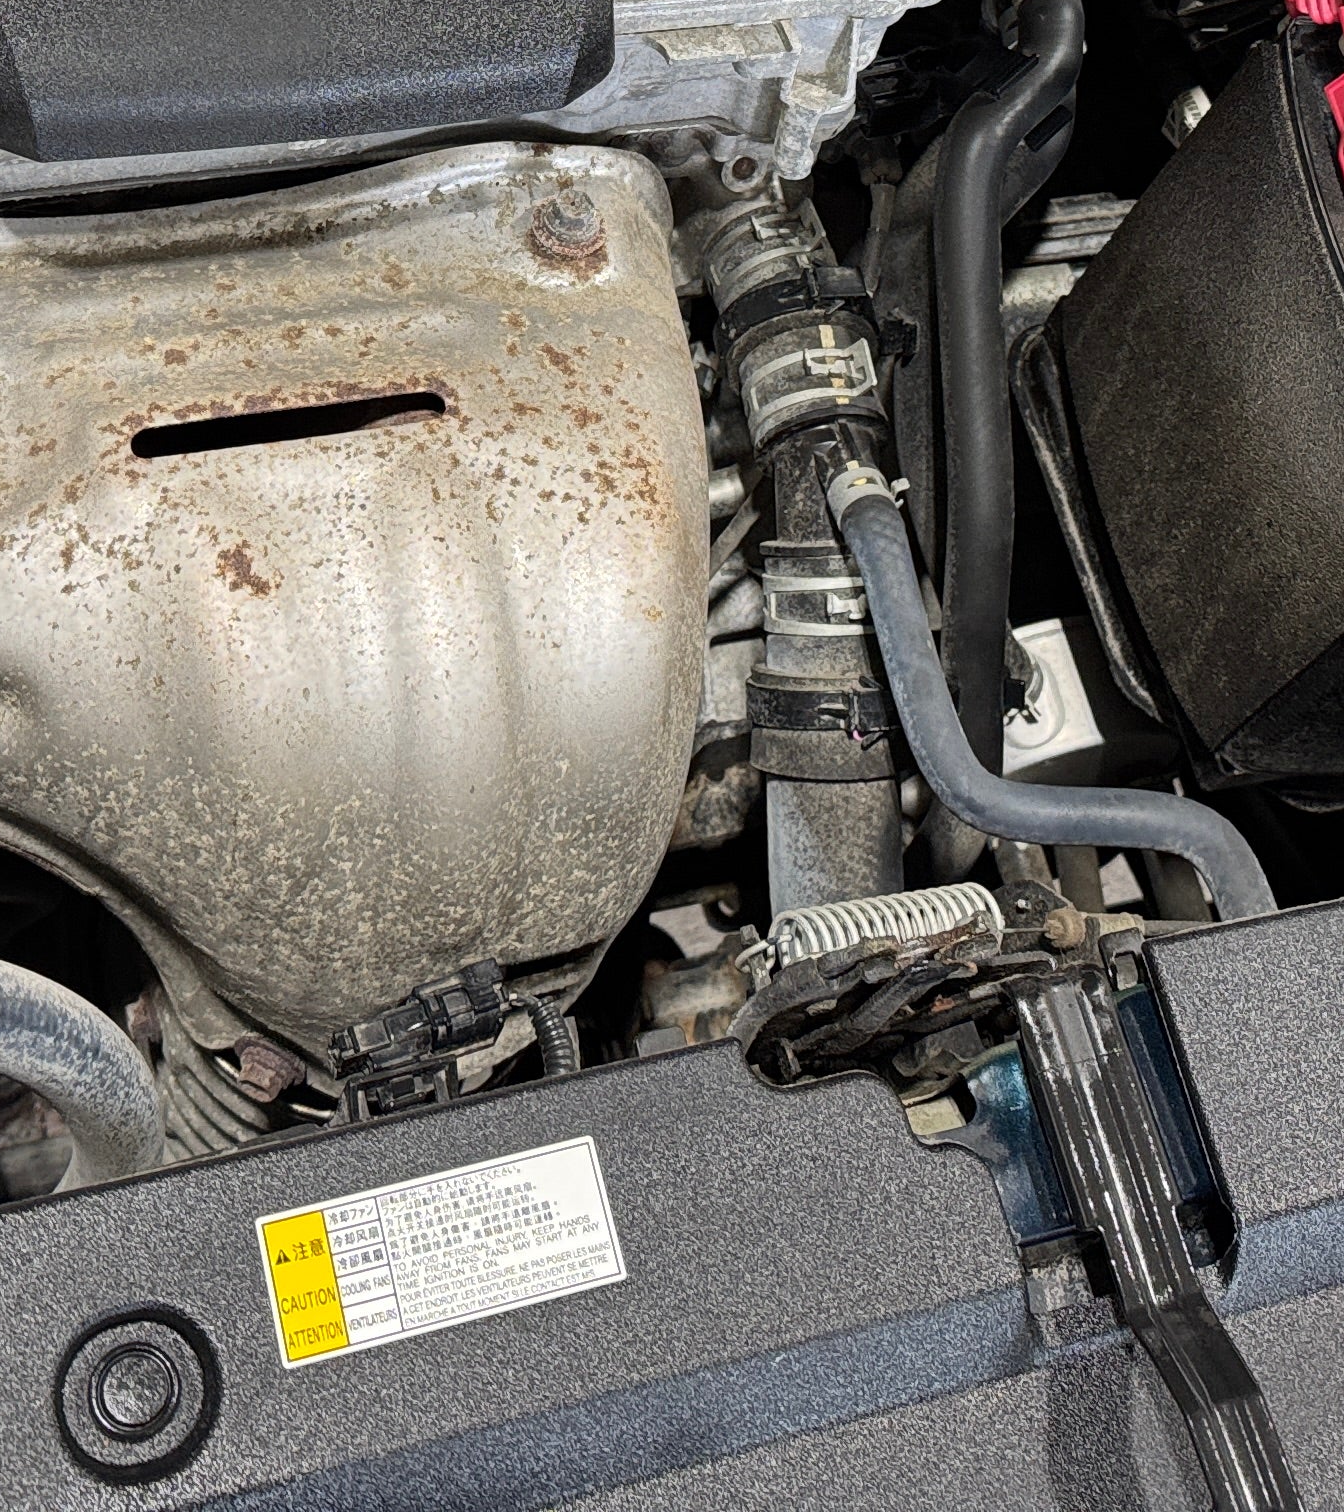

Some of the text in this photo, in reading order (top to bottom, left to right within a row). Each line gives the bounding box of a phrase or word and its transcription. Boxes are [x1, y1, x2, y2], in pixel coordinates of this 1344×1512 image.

[326, 1203, 375, 1226] 冷却ファン
[291, 1236, 326, 1261] 注意
[331, 1225, 380, 1249] 冷却风扇
[393, 1261, 407, 1273] TO
[410, 1253, 438, 1268] AVOID
[442, 1239, 491, 1260] PERSONAL
[531, 1223, 556, 1237] KEEP
[558, 1214, 591, 1230] HANDS
[395, 1268, 421, 1282] AWAY
[424, 1260, 451, 1275] FROM
[485, 1245, 509, 1259] FANS
[512, 1239, 532, 1252] MAY
[534, 1230, 563, 1246] START
[566, 1226, 579, 1238] AT
[581, 1221, 601, 1234] ANY
[340, 1273, 391, 1297] COOLING FANS
[397, 1278, 420, 1292] TIME
[423, 1266, 465, 1285] IGNITION
[469, 1262, 479, 1273] IS
[399, 1289, 422, 1304] POUR
[450, 1275, 476, 1290] TOUTE
[476, 1264, 517, 1284] BLESSURE
[518, 1260, 530, 1273] NE
[530, 1256, 546, 1269] PAS
[545, 1249, 572, 1265] POSER
[571, 1245, 587, 1258] LES
[586, 1239, 611, 1254] MAINS
[407, 1301, 424, 1314] CET
[460, 1287, 476, 1300] LES
[476, 1273, 532, 1296] VENTILATEURS
[531, 1263, 567, 1281] PEUVENT
[566, 1261, 577, 1272] SE
[577, 1252, 609, 1269] METTRE
[279, 1285, 337, 1315] CAUTION
[404, 1315, 416, 1327] EN
[416, 1307, 449, 1324] MARCHE
[456, 1299, 477, 1313] TOUT
[477, 1290, 511, 1307] MOMENT
[530, 1275, 566, 1293] CONTACT
[565, 1271, 581, 1284] EST
[286, 1319, 344, 1350] ATTENTION
[347, 1307, 398, 1332] VENTILATEURS
